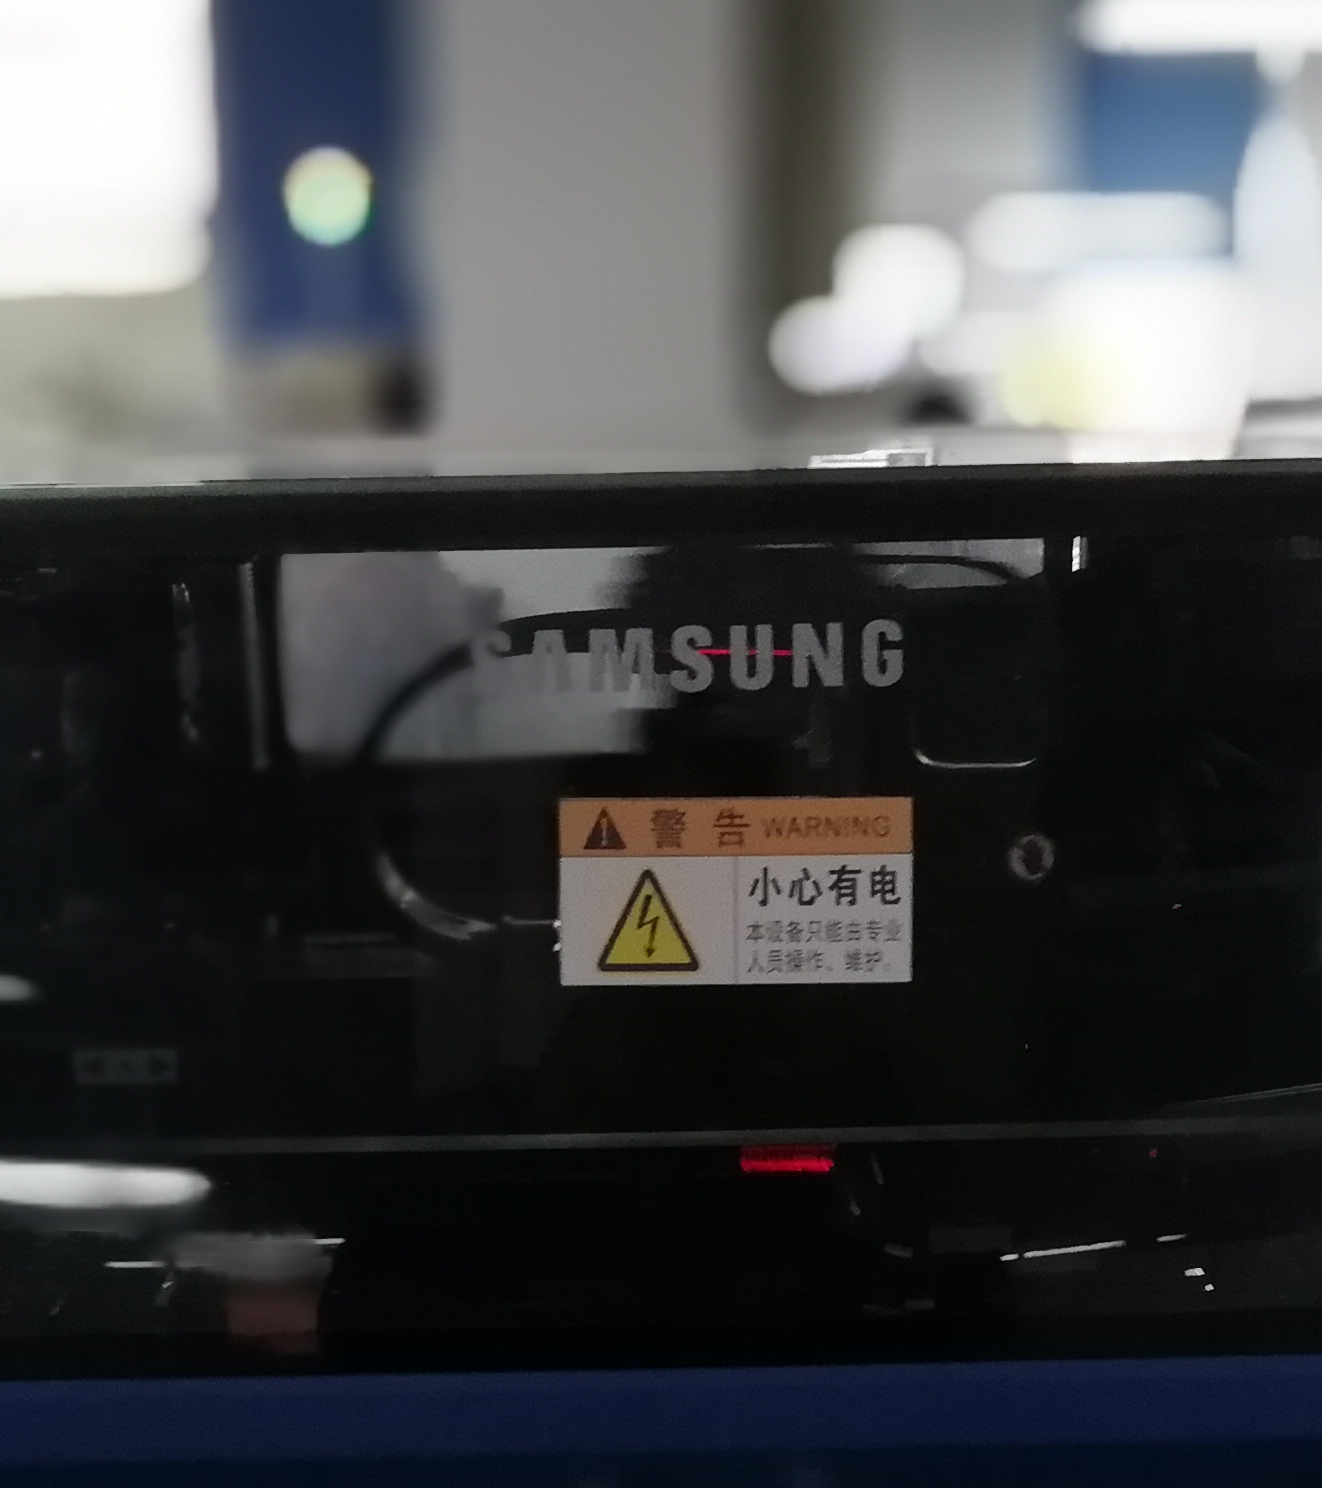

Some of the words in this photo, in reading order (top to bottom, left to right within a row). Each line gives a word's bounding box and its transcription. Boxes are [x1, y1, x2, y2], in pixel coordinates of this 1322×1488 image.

[650, 806, 750, 850] 警告
[760, 815, 892, 839] WARNING
[749, 864, 902, 908] 小心有电
